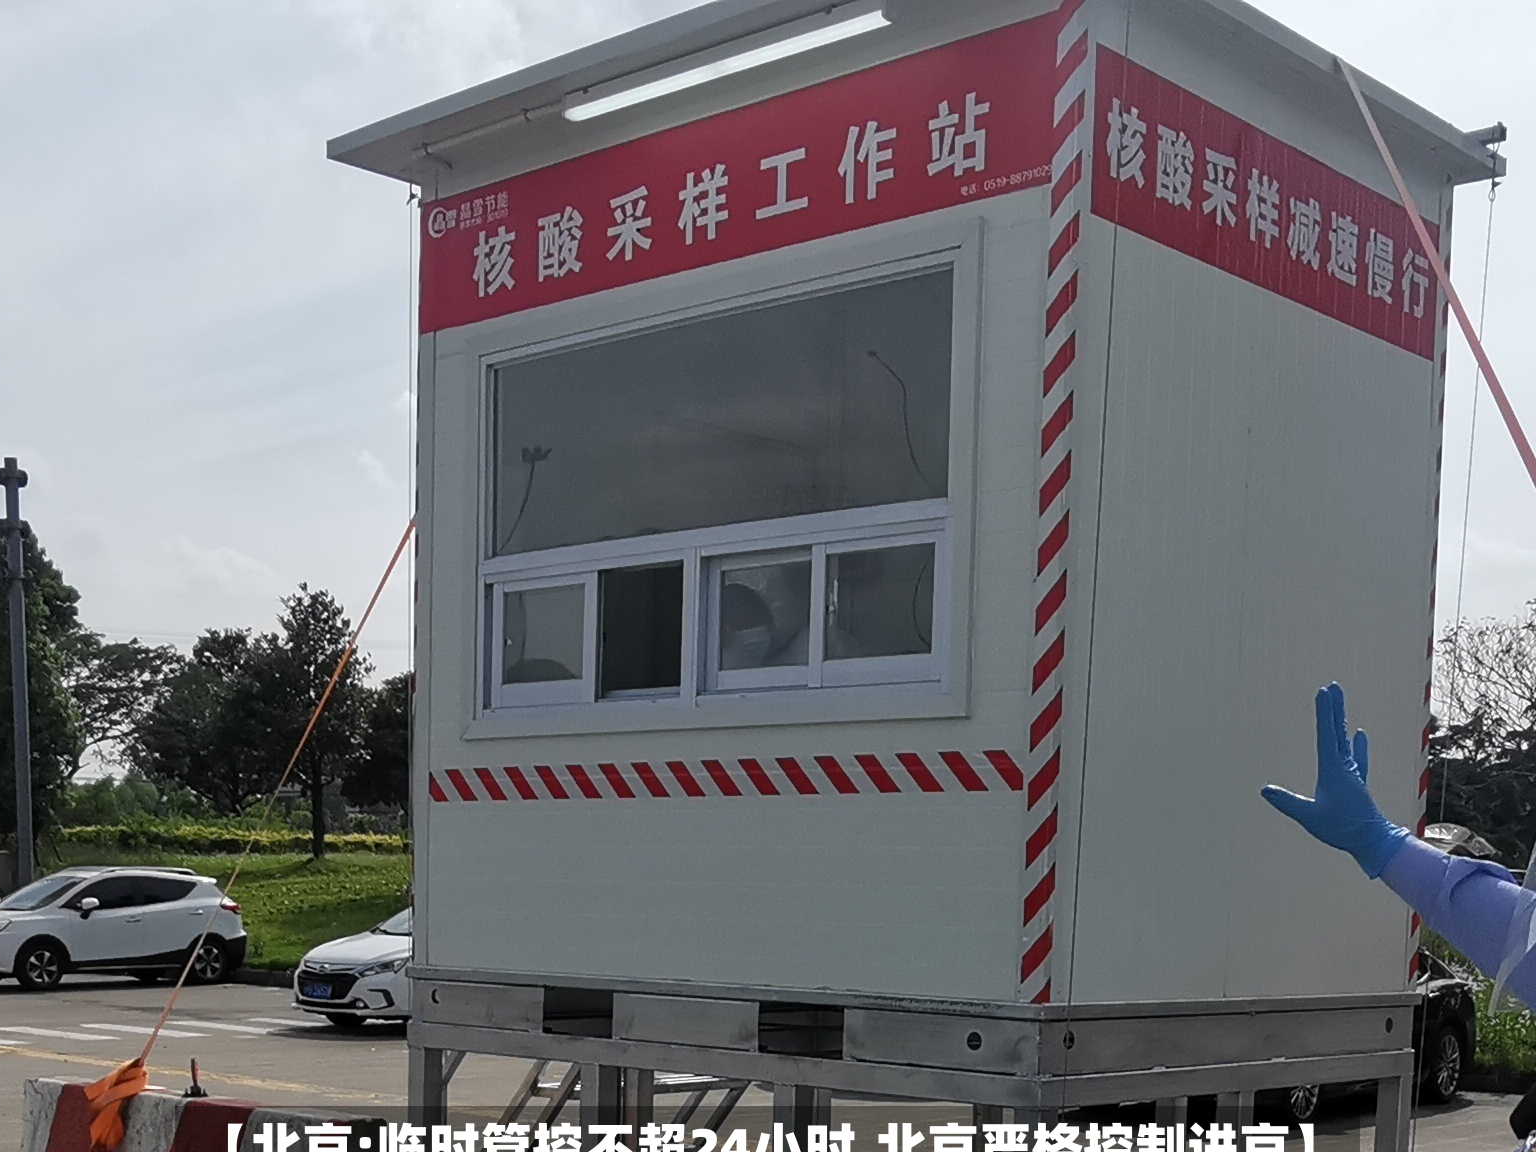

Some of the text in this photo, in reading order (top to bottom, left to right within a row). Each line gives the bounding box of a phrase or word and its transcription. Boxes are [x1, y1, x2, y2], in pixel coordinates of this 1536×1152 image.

[472, 91, 991, 297] 核酸采样工作站
[1106, 97, 1429, 319] 核酸采样减速慢行
